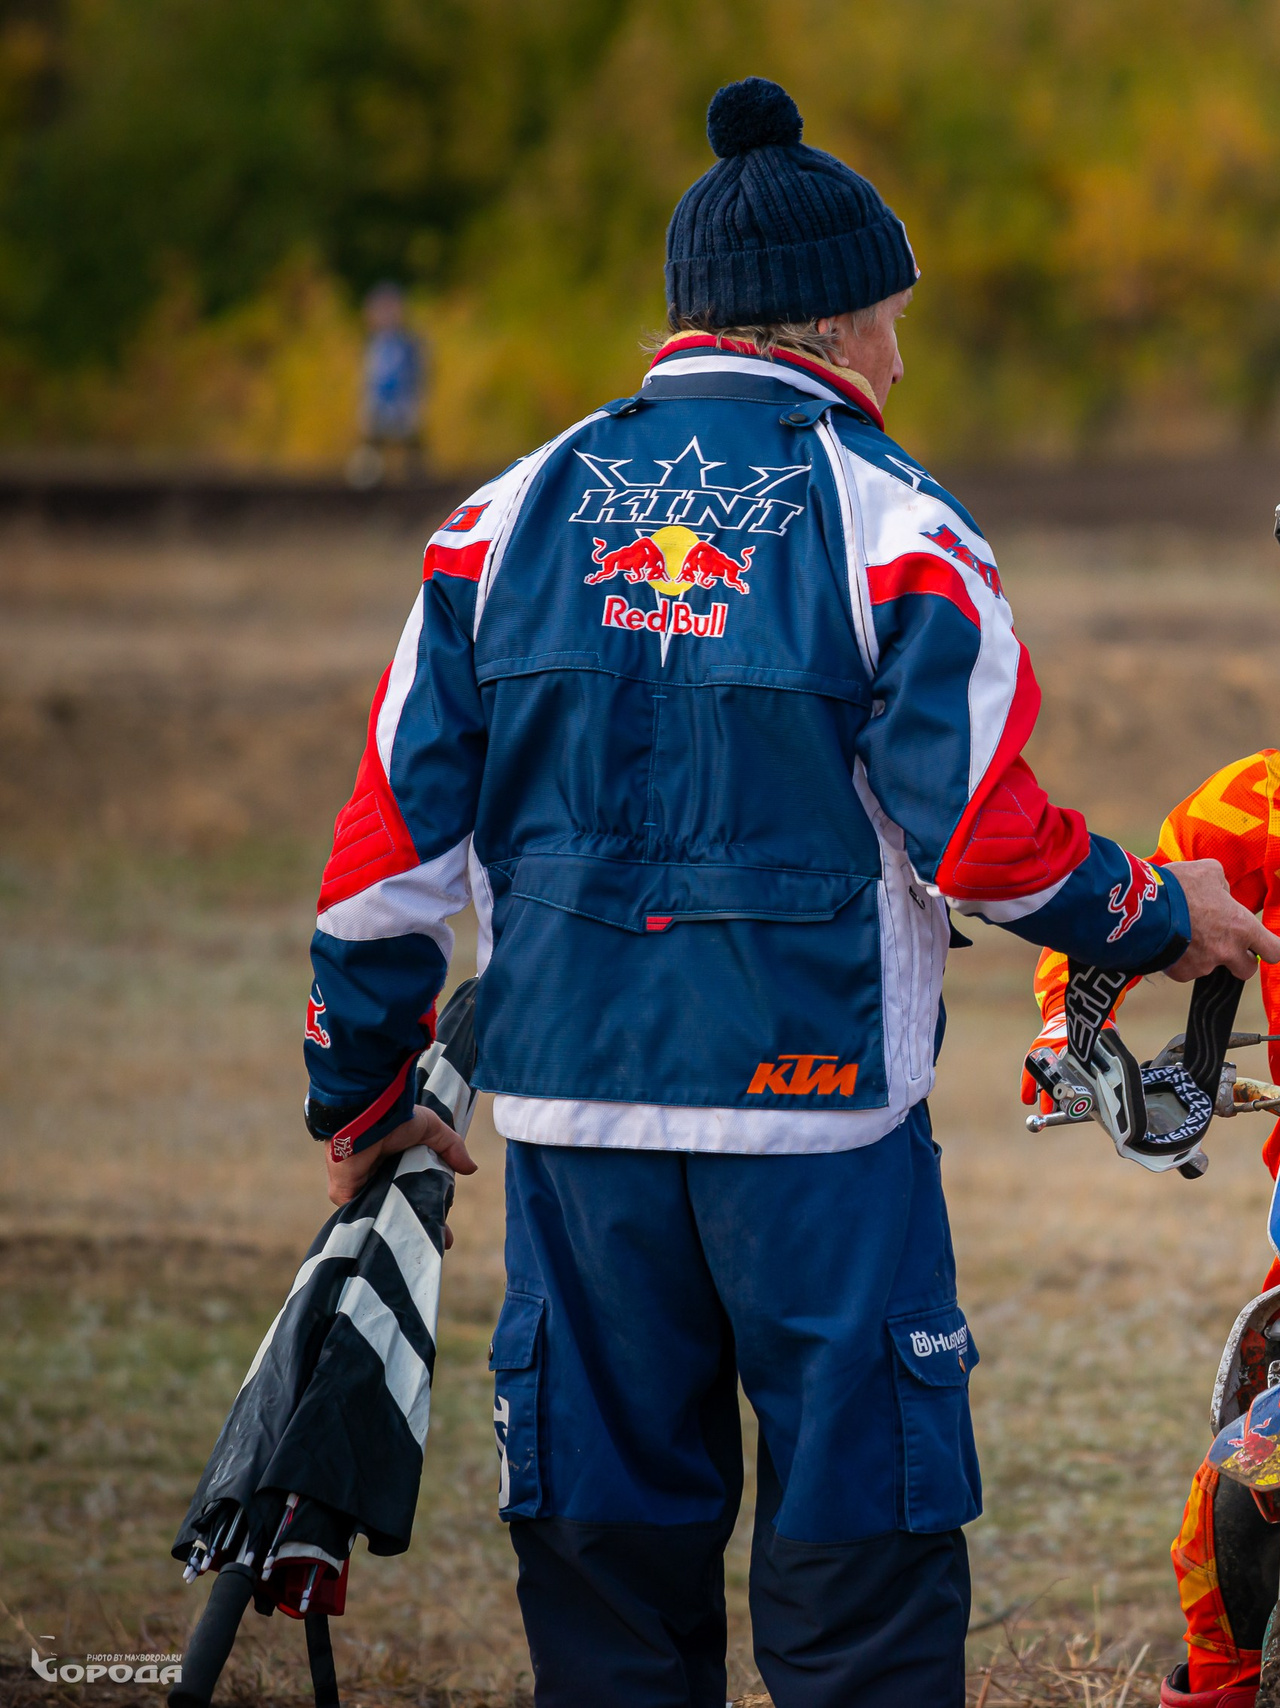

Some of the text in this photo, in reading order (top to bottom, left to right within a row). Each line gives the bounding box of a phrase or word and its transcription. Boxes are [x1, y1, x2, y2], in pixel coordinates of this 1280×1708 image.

[568, 488, 804, 536] KINI
[601, 595, 729, 637] Red Bull
[746, 1054, 859, 1097] KTM
